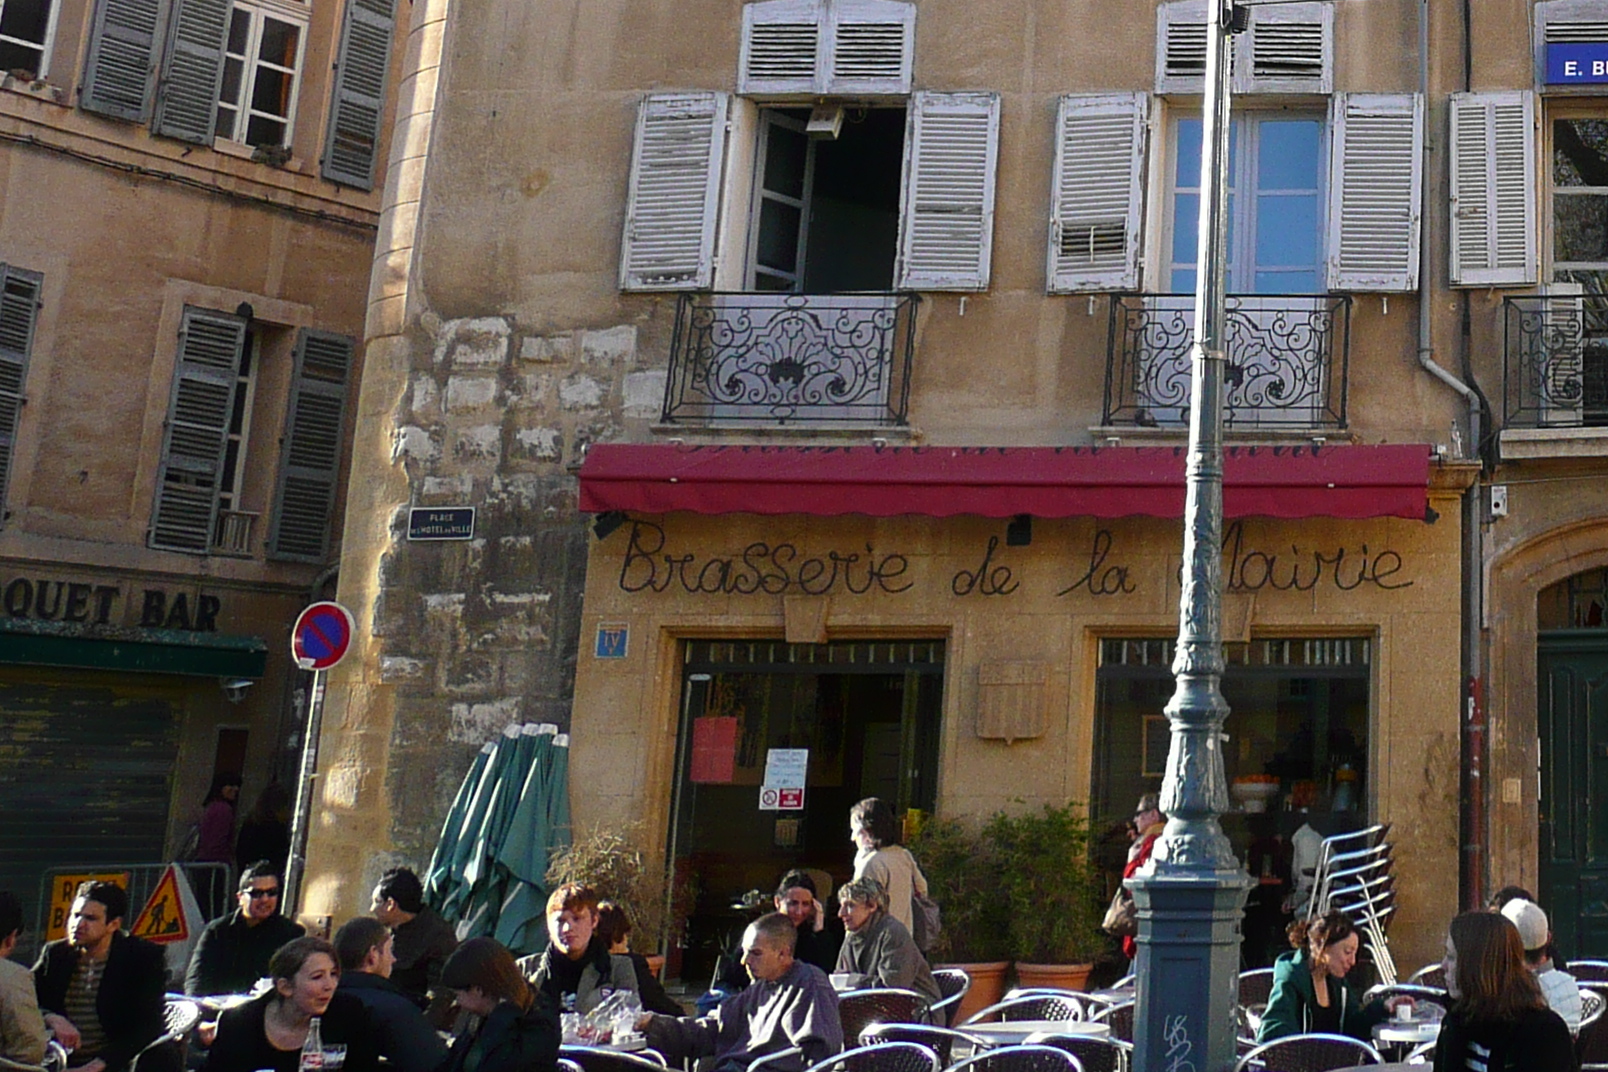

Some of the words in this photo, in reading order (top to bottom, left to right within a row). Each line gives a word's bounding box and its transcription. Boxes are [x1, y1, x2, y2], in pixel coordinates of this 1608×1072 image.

[1564, 60, 1583, 77] E.
[619, 518, 914, 596] Brasserie
[952, 535, 1021, 596] de
[1056, 530, 1137, 597] la
[139, 588, 221, 631] BAR
